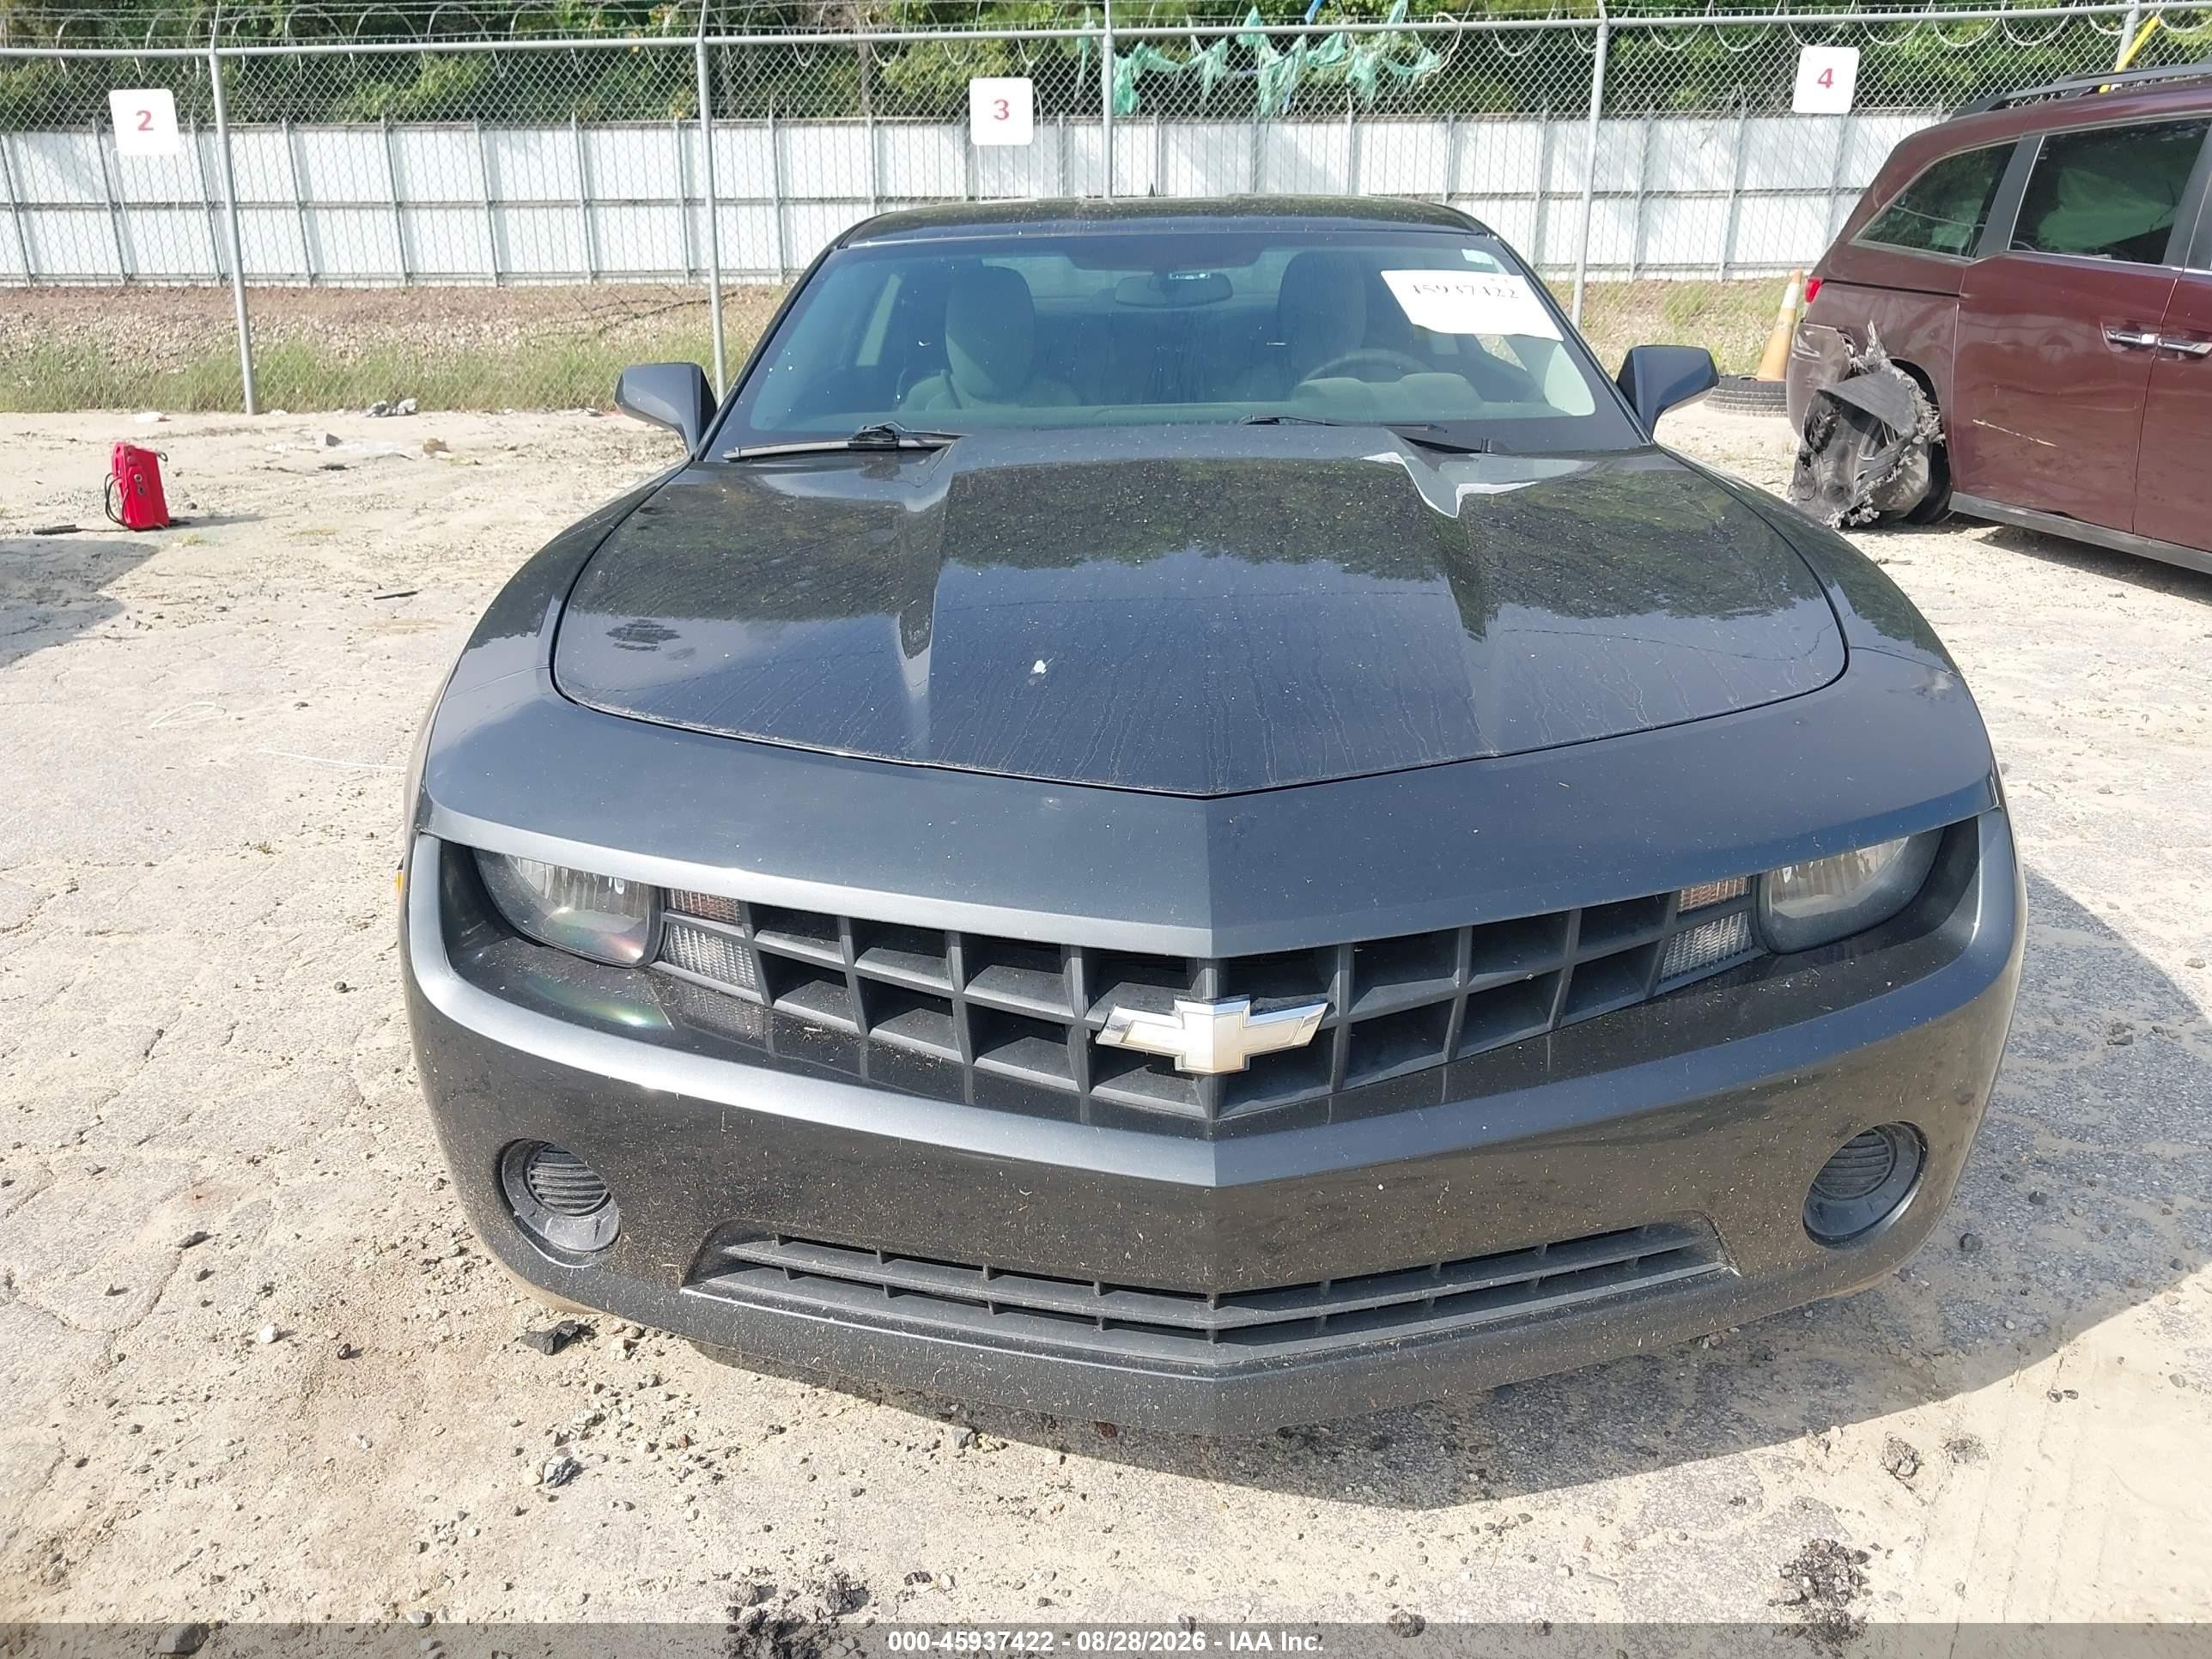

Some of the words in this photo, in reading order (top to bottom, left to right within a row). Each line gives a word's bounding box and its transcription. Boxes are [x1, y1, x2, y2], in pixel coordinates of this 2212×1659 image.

[1817, 68, 1834, 88] 4
[994, 99, 1010, 120] 3
[136, 110, 155, 131] 2
